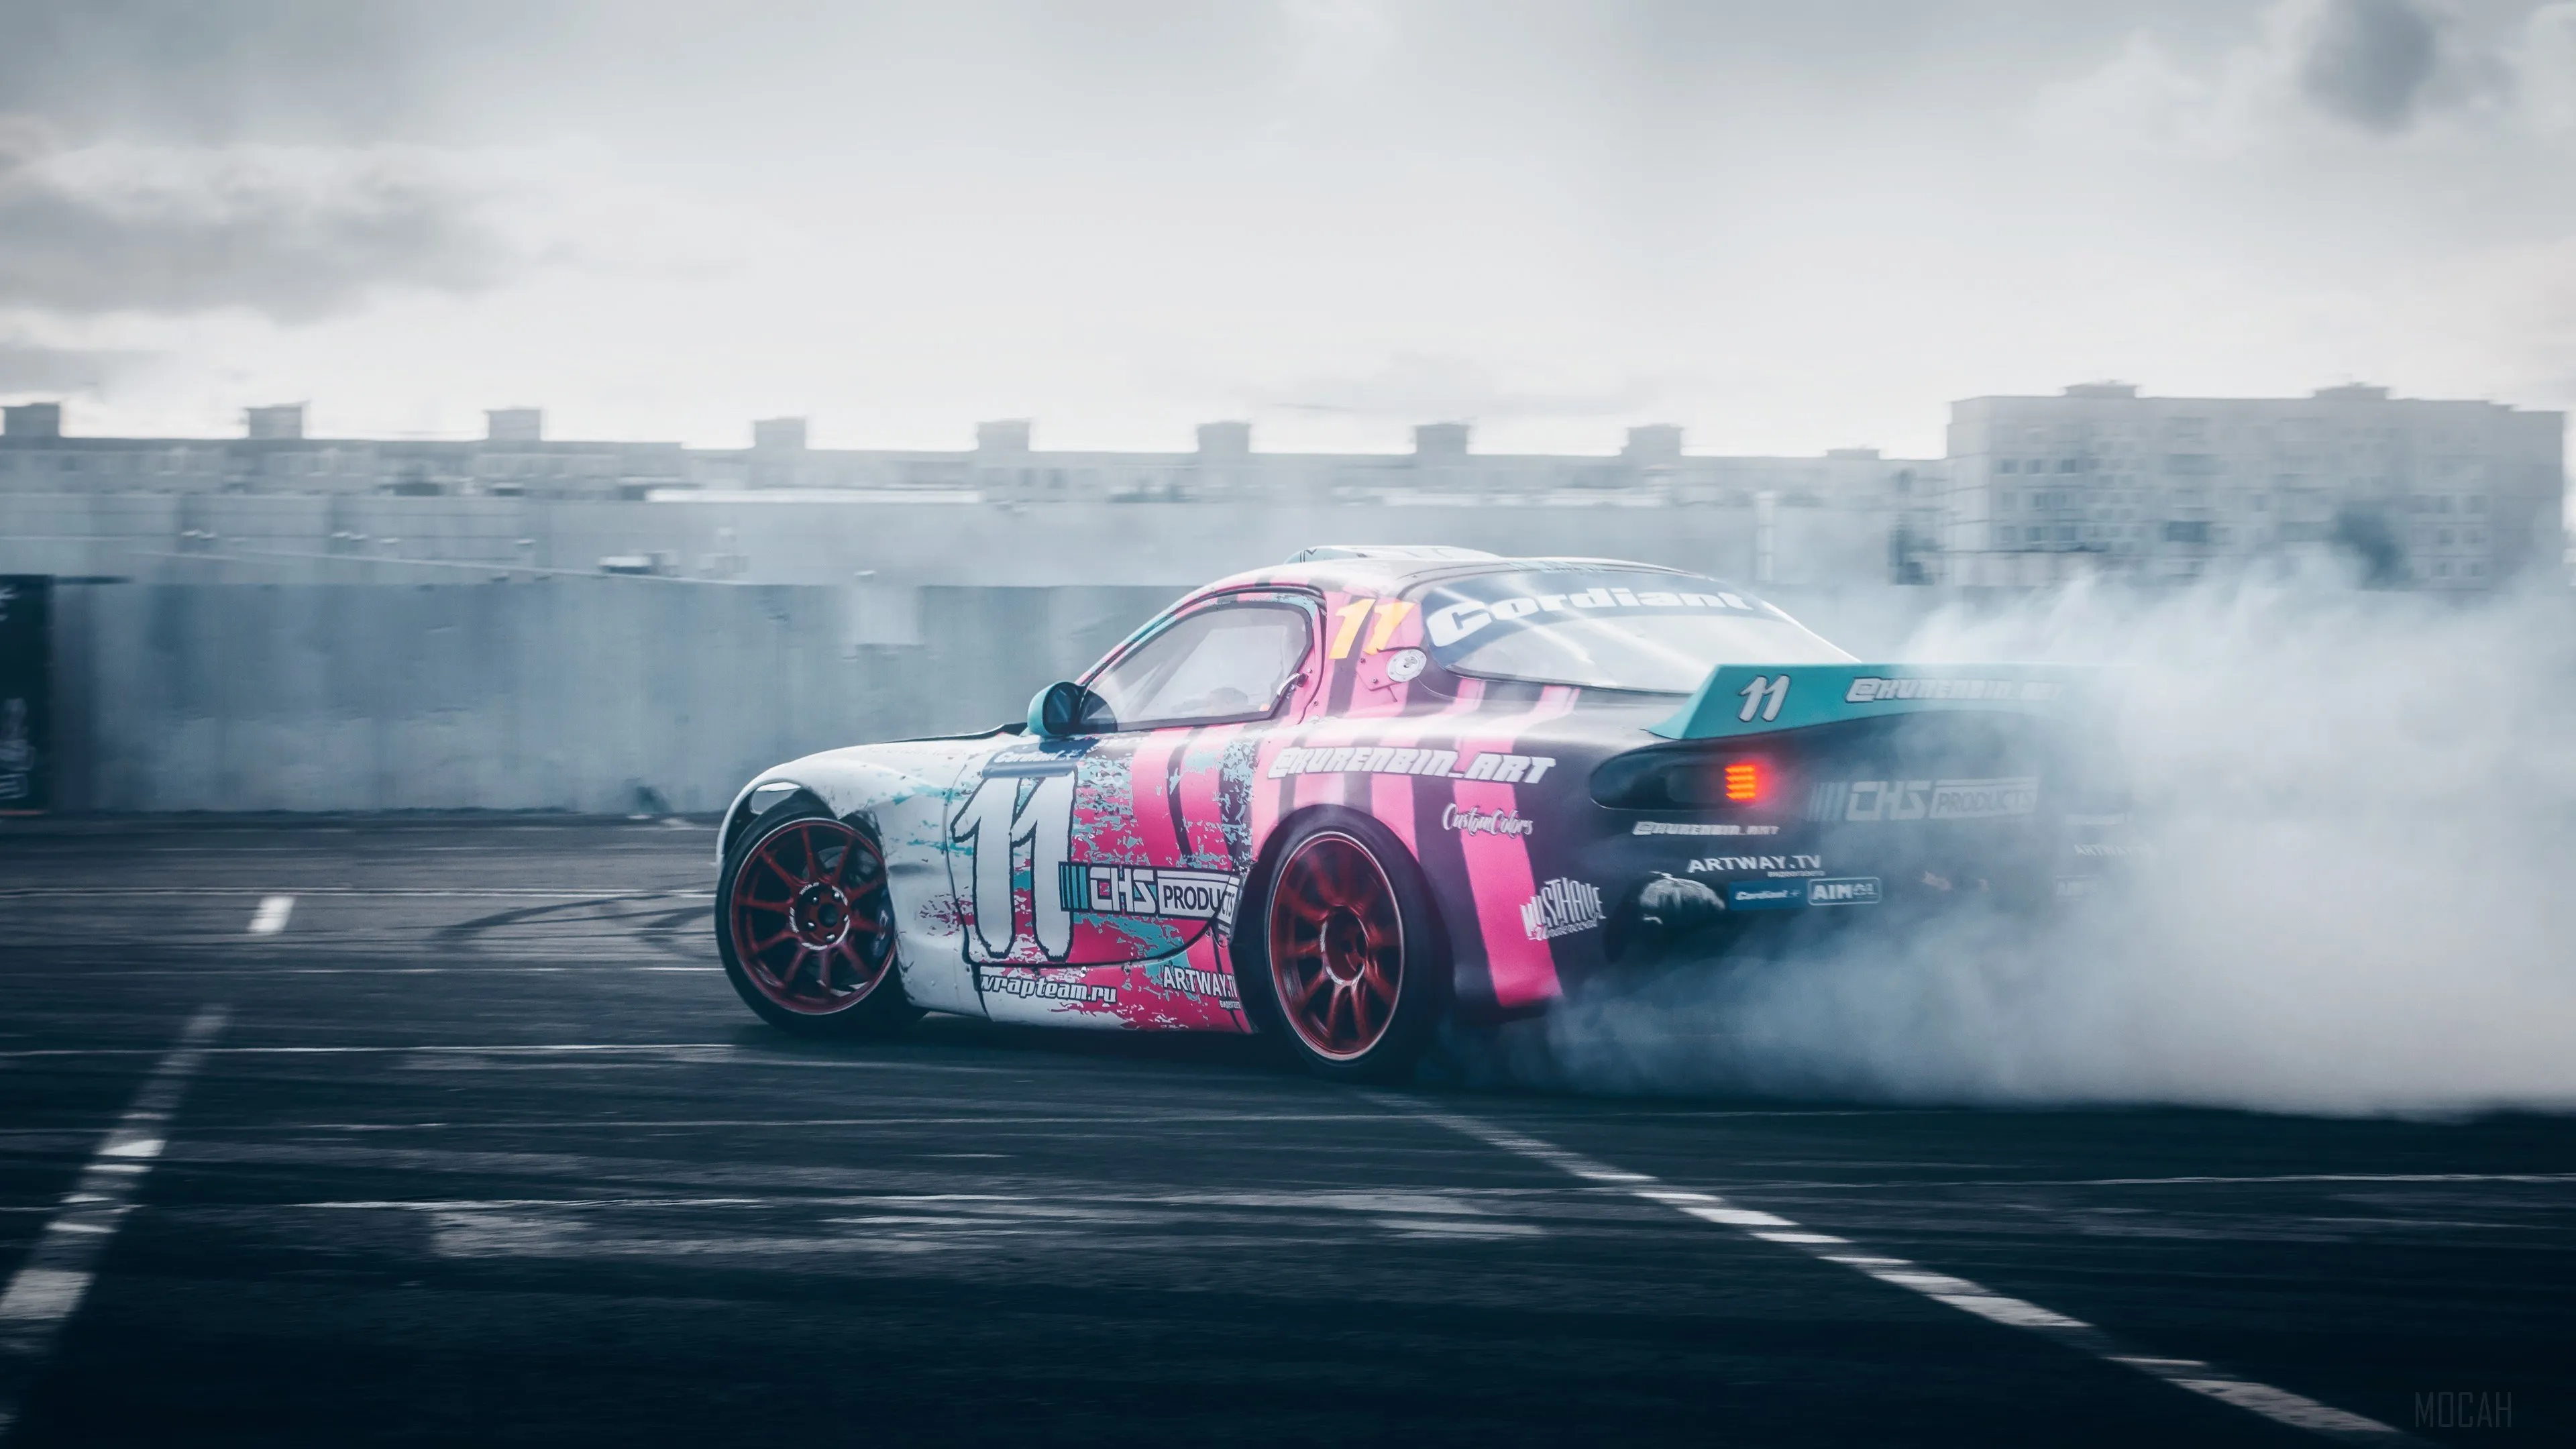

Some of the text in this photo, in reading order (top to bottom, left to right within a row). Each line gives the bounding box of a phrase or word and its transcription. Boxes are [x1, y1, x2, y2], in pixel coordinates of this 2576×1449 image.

[1328, 598, 1417, 659] 11
[1427, 587, 1754, 647] Cordiant
[1737, 674, 1791, 722] 11
[1846, 780, 1932, 822] CHS
[950, 773, 1077, 962] 11
[1686, 855, 1822, 873] ARTWAY.TV
[1089, 866, 1157, 914] CHS
